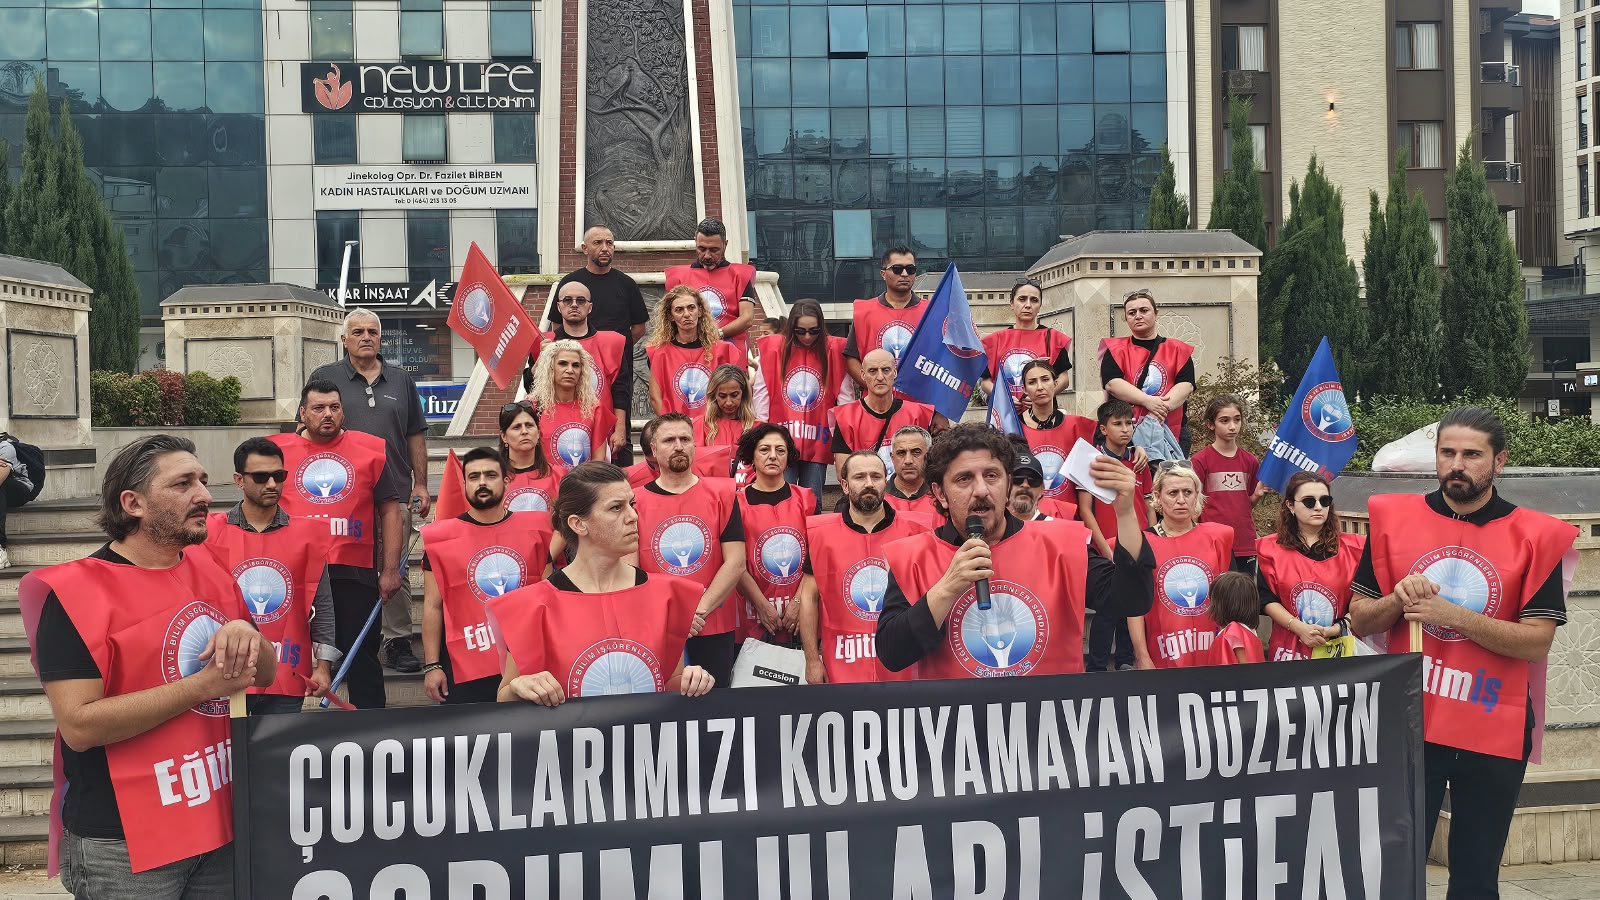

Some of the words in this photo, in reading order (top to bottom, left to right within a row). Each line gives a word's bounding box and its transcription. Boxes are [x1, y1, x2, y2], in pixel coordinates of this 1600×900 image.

[444, 95, 455, 109] &
[347, 171, 394, 182] Jinekolog
[396, 171, 417, 181] Opr.
[419, 171, 433, 180] Dr.
[435, 171, 467, 180] Fazilet
[469, 169, 503, 179] BİRBEN
[320, 187, 354, 196] KADIN
[356, 187, 428, 196] HASTALIKLARI
[431, 188, 443, 196] ve
[445, 185, 487, 195] DOĞUM
[489, 186, 530, 195] UZMANI
[322, 287, 361, 301] KAR
[364, 284, 411, 302] İNŞAAT
[1562, 382, 1578, 393] TA
[956, 593, 975, 615] BİLİM
[990, 584, 1034, 604] ÖRENLERİ
[575, 652, 596, 675] BİLİM
[652, 667, 663, 692] SEND
[758, 669, 795, 683] occasion
[289, 716, 758, 863] ÇOCUKLARIMIZI
[779, 694, 1166, 808] KORUYAMAYAN
[1177, 681, 1383, 782] DÜZENİN
